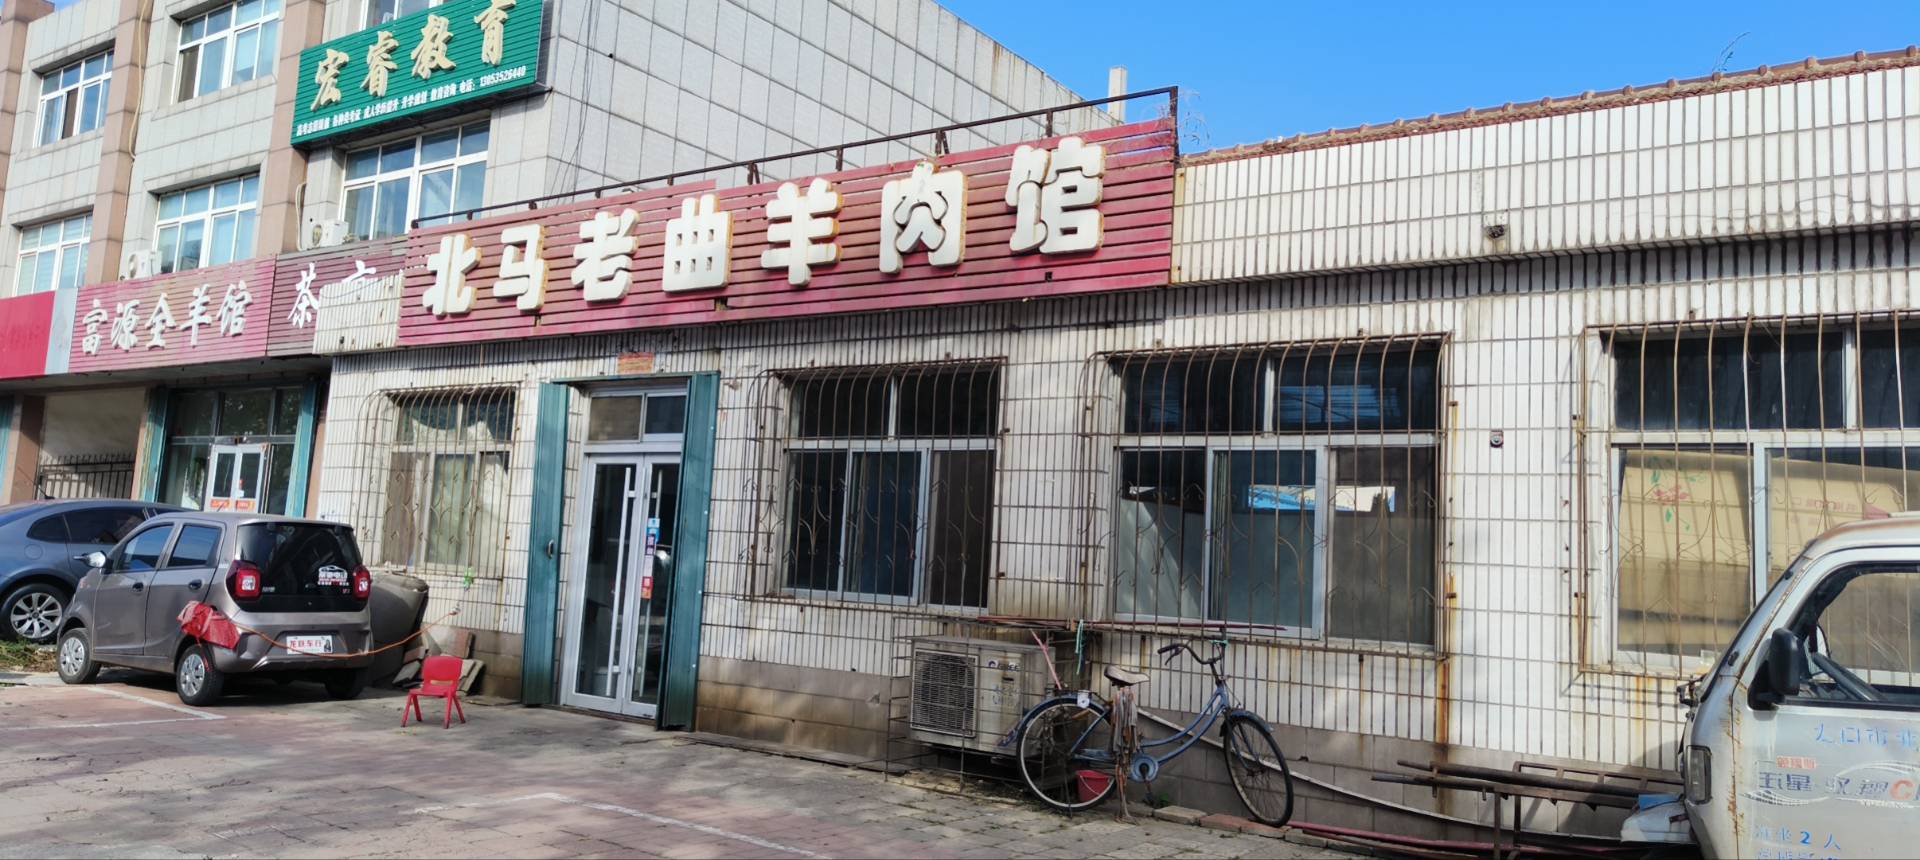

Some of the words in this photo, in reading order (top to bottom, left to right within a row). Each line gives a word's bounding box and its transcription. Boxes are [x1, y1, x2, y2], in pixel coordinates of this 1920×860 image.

[310, 0, 517, 112] 宏睿教育
[363, 98, 399, 119] 成人学历提升
[421, 135, 1107, 319] 北马老曲羊肉馆
[81, 279, 254, 356] 富源全羊馆
